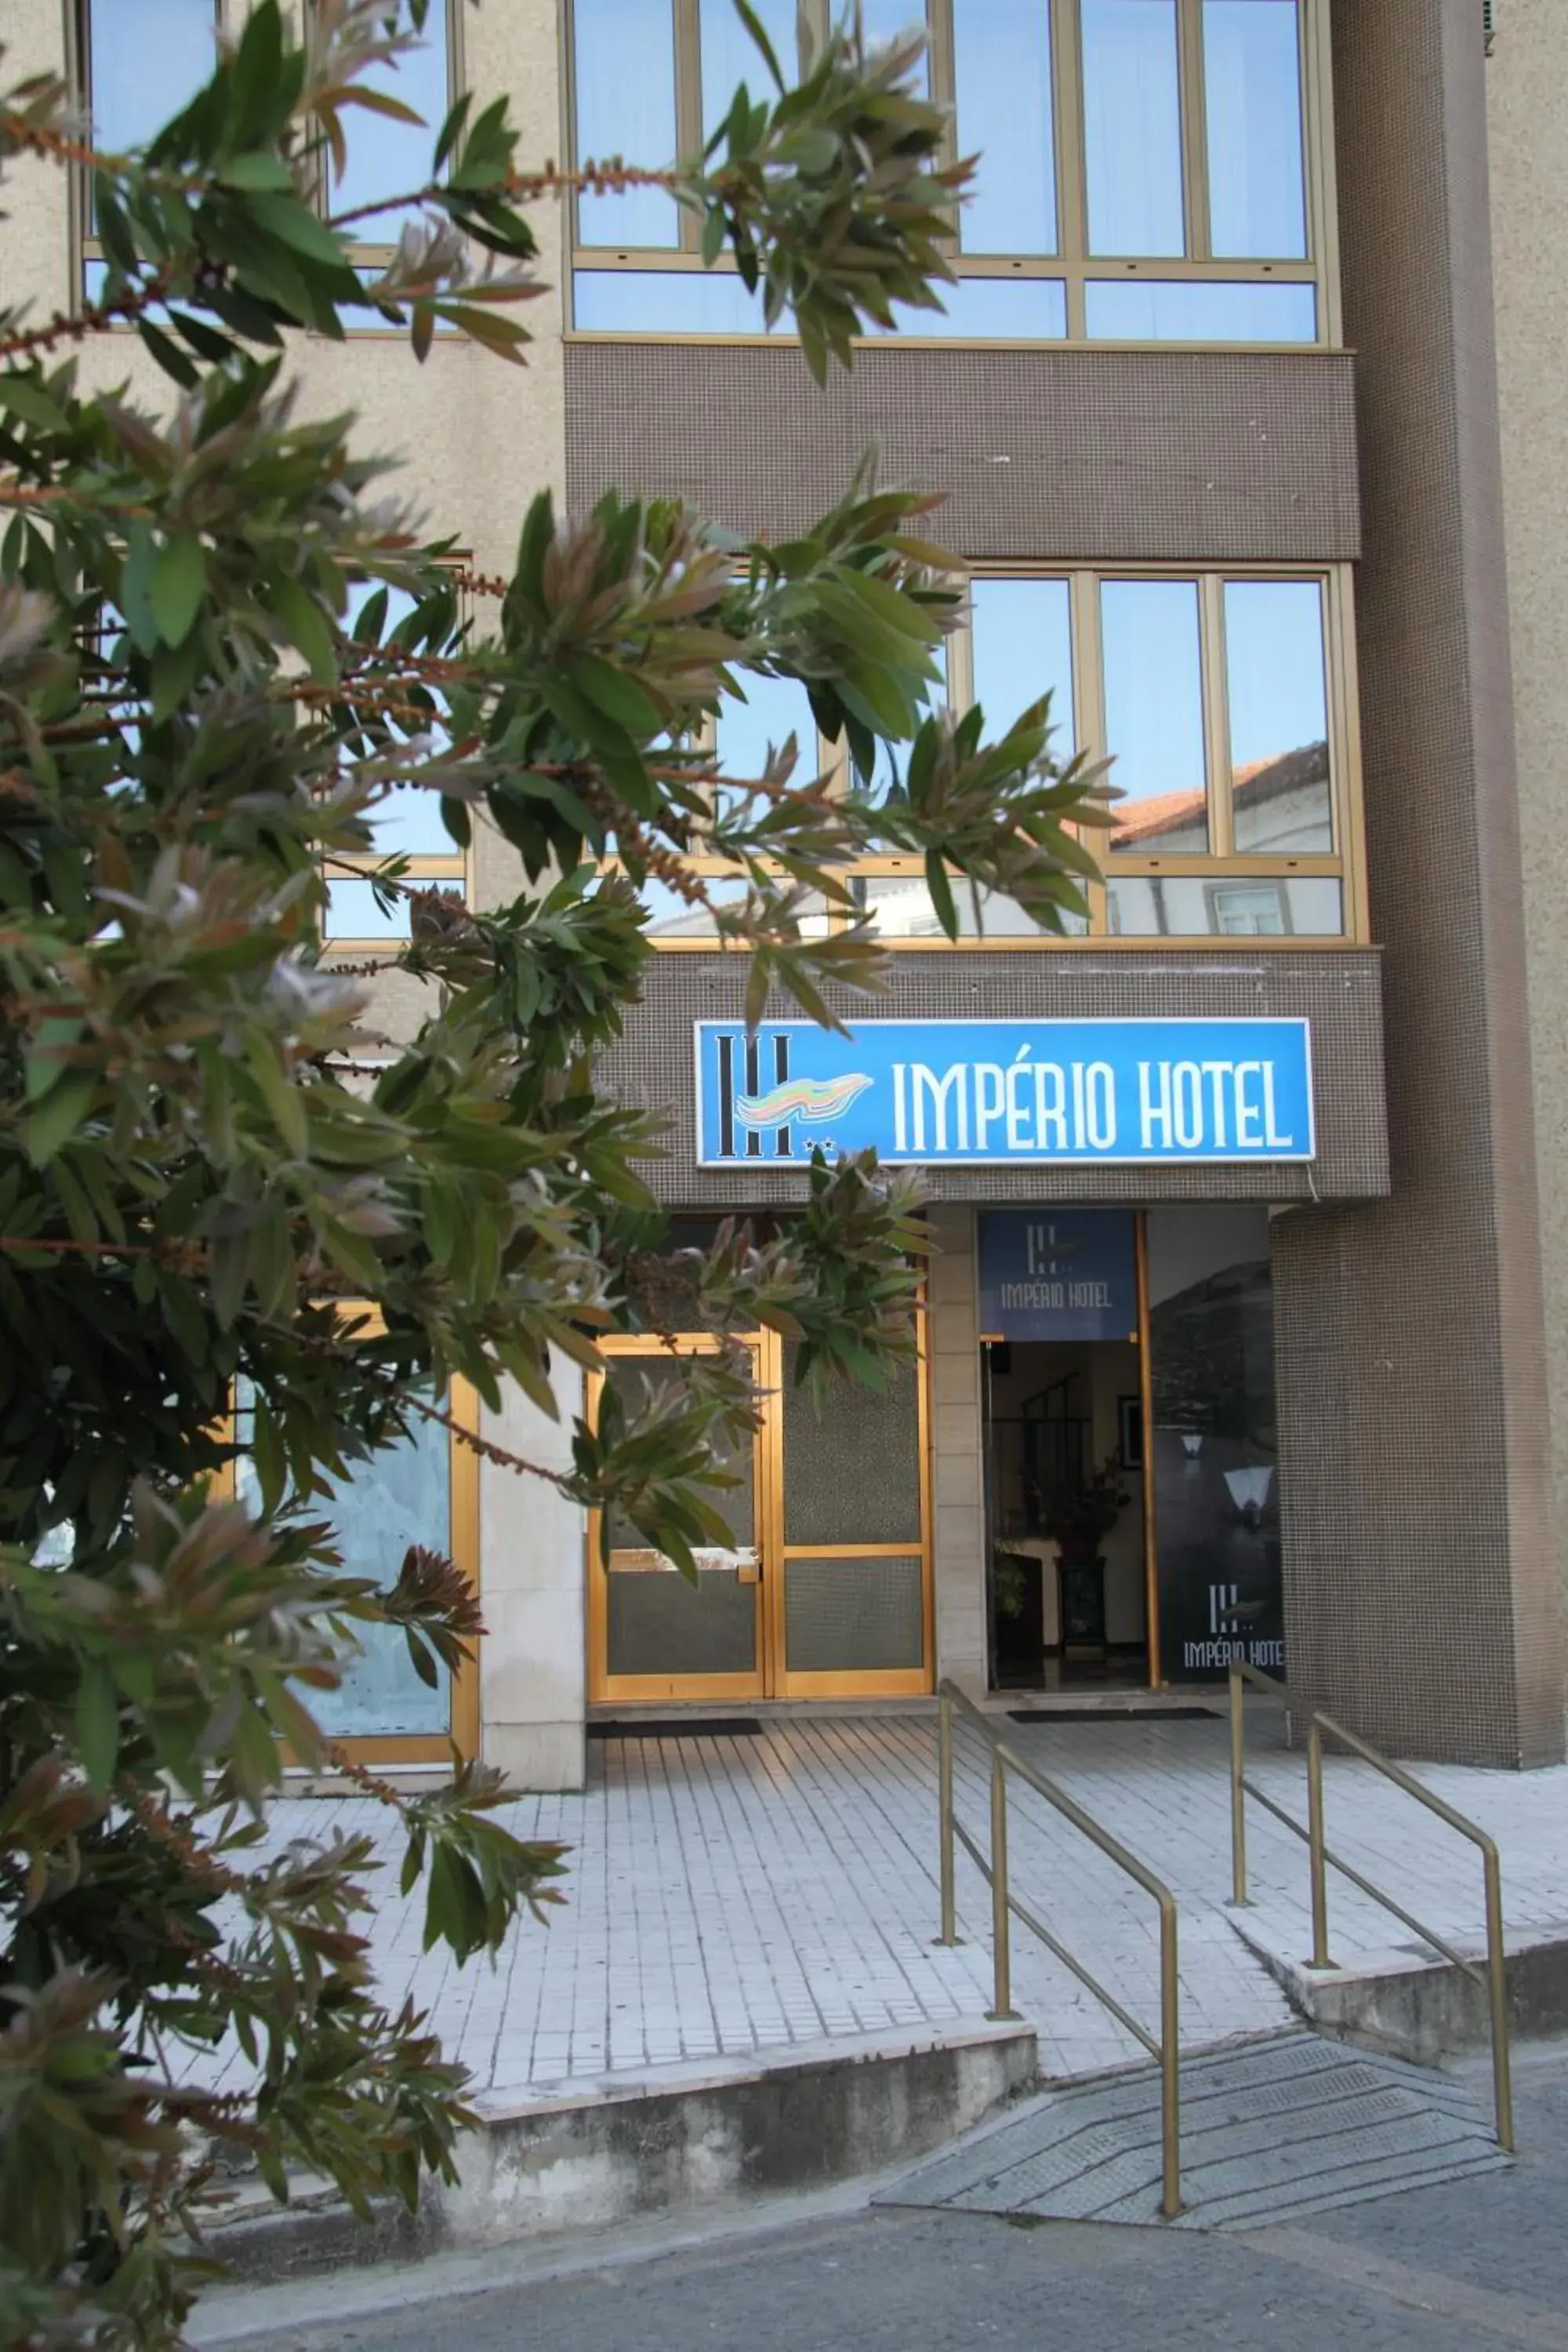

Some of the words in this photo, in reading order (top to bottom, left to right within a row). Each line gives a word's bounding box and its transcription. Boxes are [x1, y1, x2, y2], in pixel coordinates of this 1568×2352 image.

[891, 1043, 1118, 1152] IMPÉRIO
[1138, 1061, 1293, 1149] HOTEL
[1000, 1277, 1065, 1310] IMPÉRIO
[1069, 1282, 1113, 1308] HOTEL
[1250, 1640, 1284, 1667] HOTE
